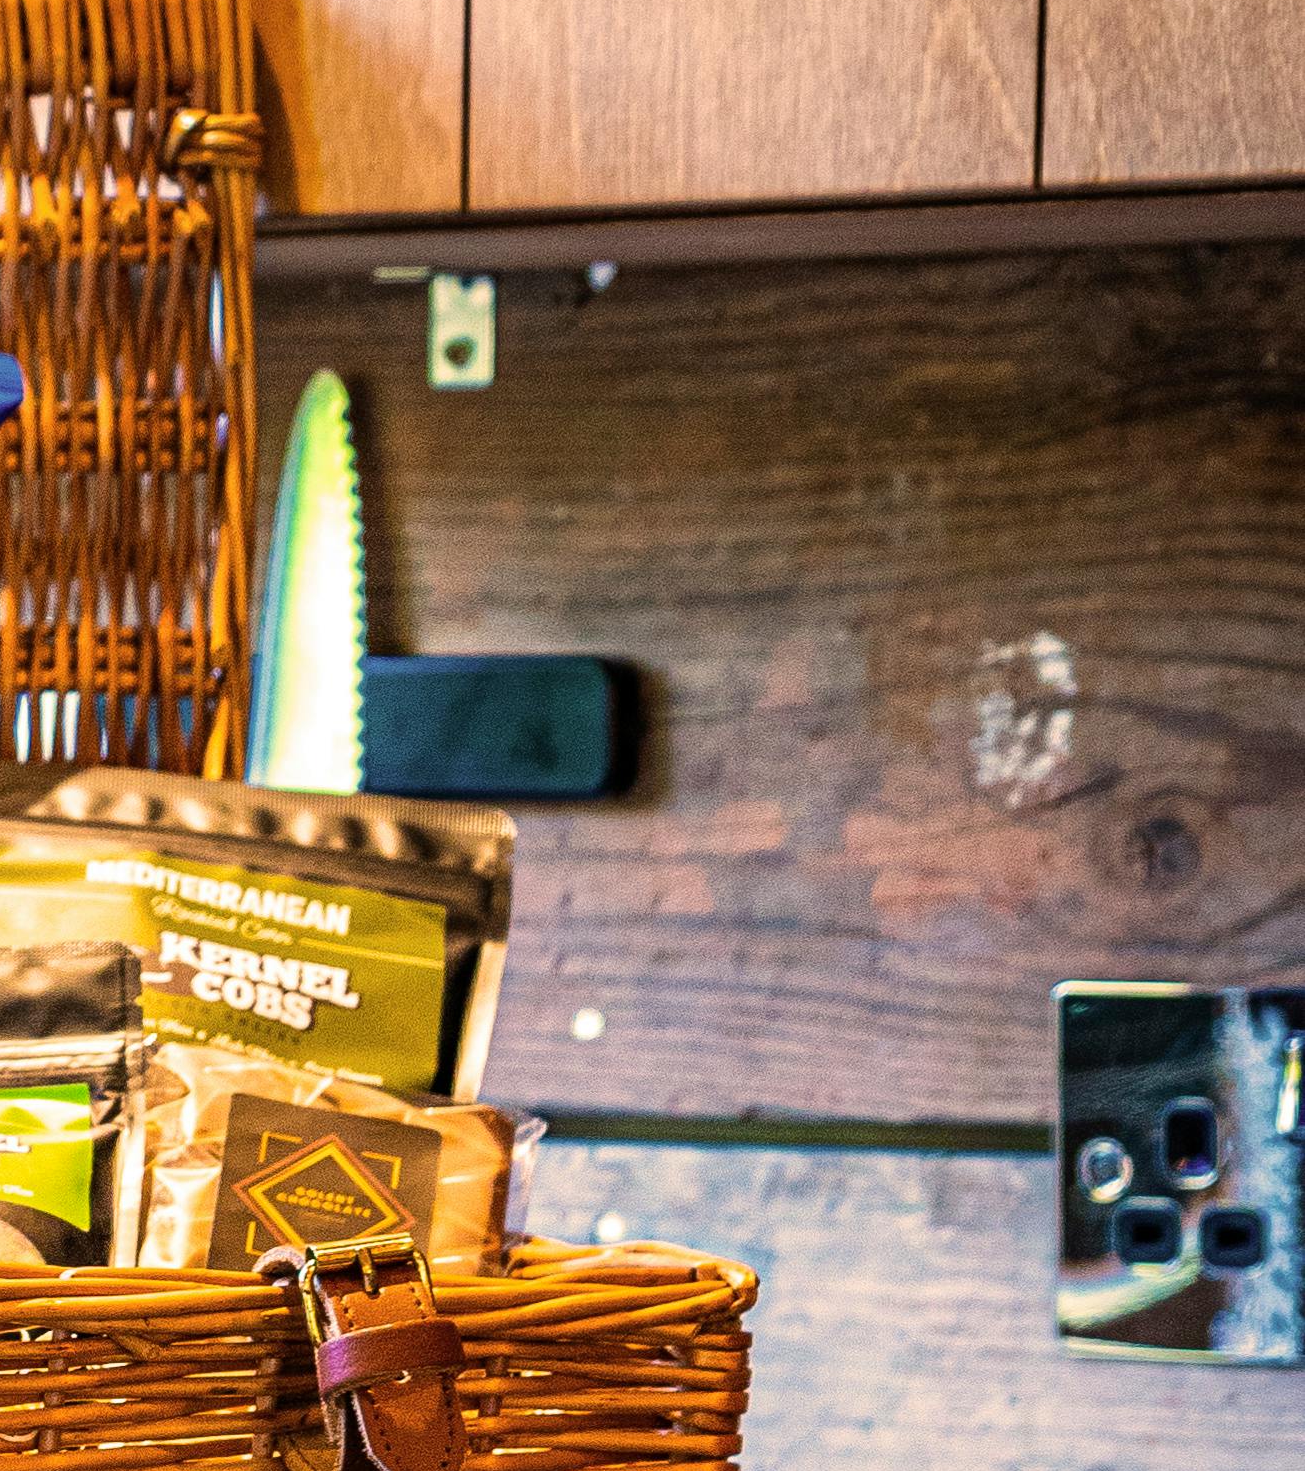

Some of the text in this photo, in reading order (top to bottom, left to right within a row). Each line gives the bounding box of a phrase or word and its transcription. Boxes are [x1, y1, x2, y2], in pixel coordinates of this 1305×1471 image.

[86, 860, 352, 936] MEDITERRANEAN
[159, 930, 361, 1009] KERNEL
[190, 971, 314, 1031] COBS
